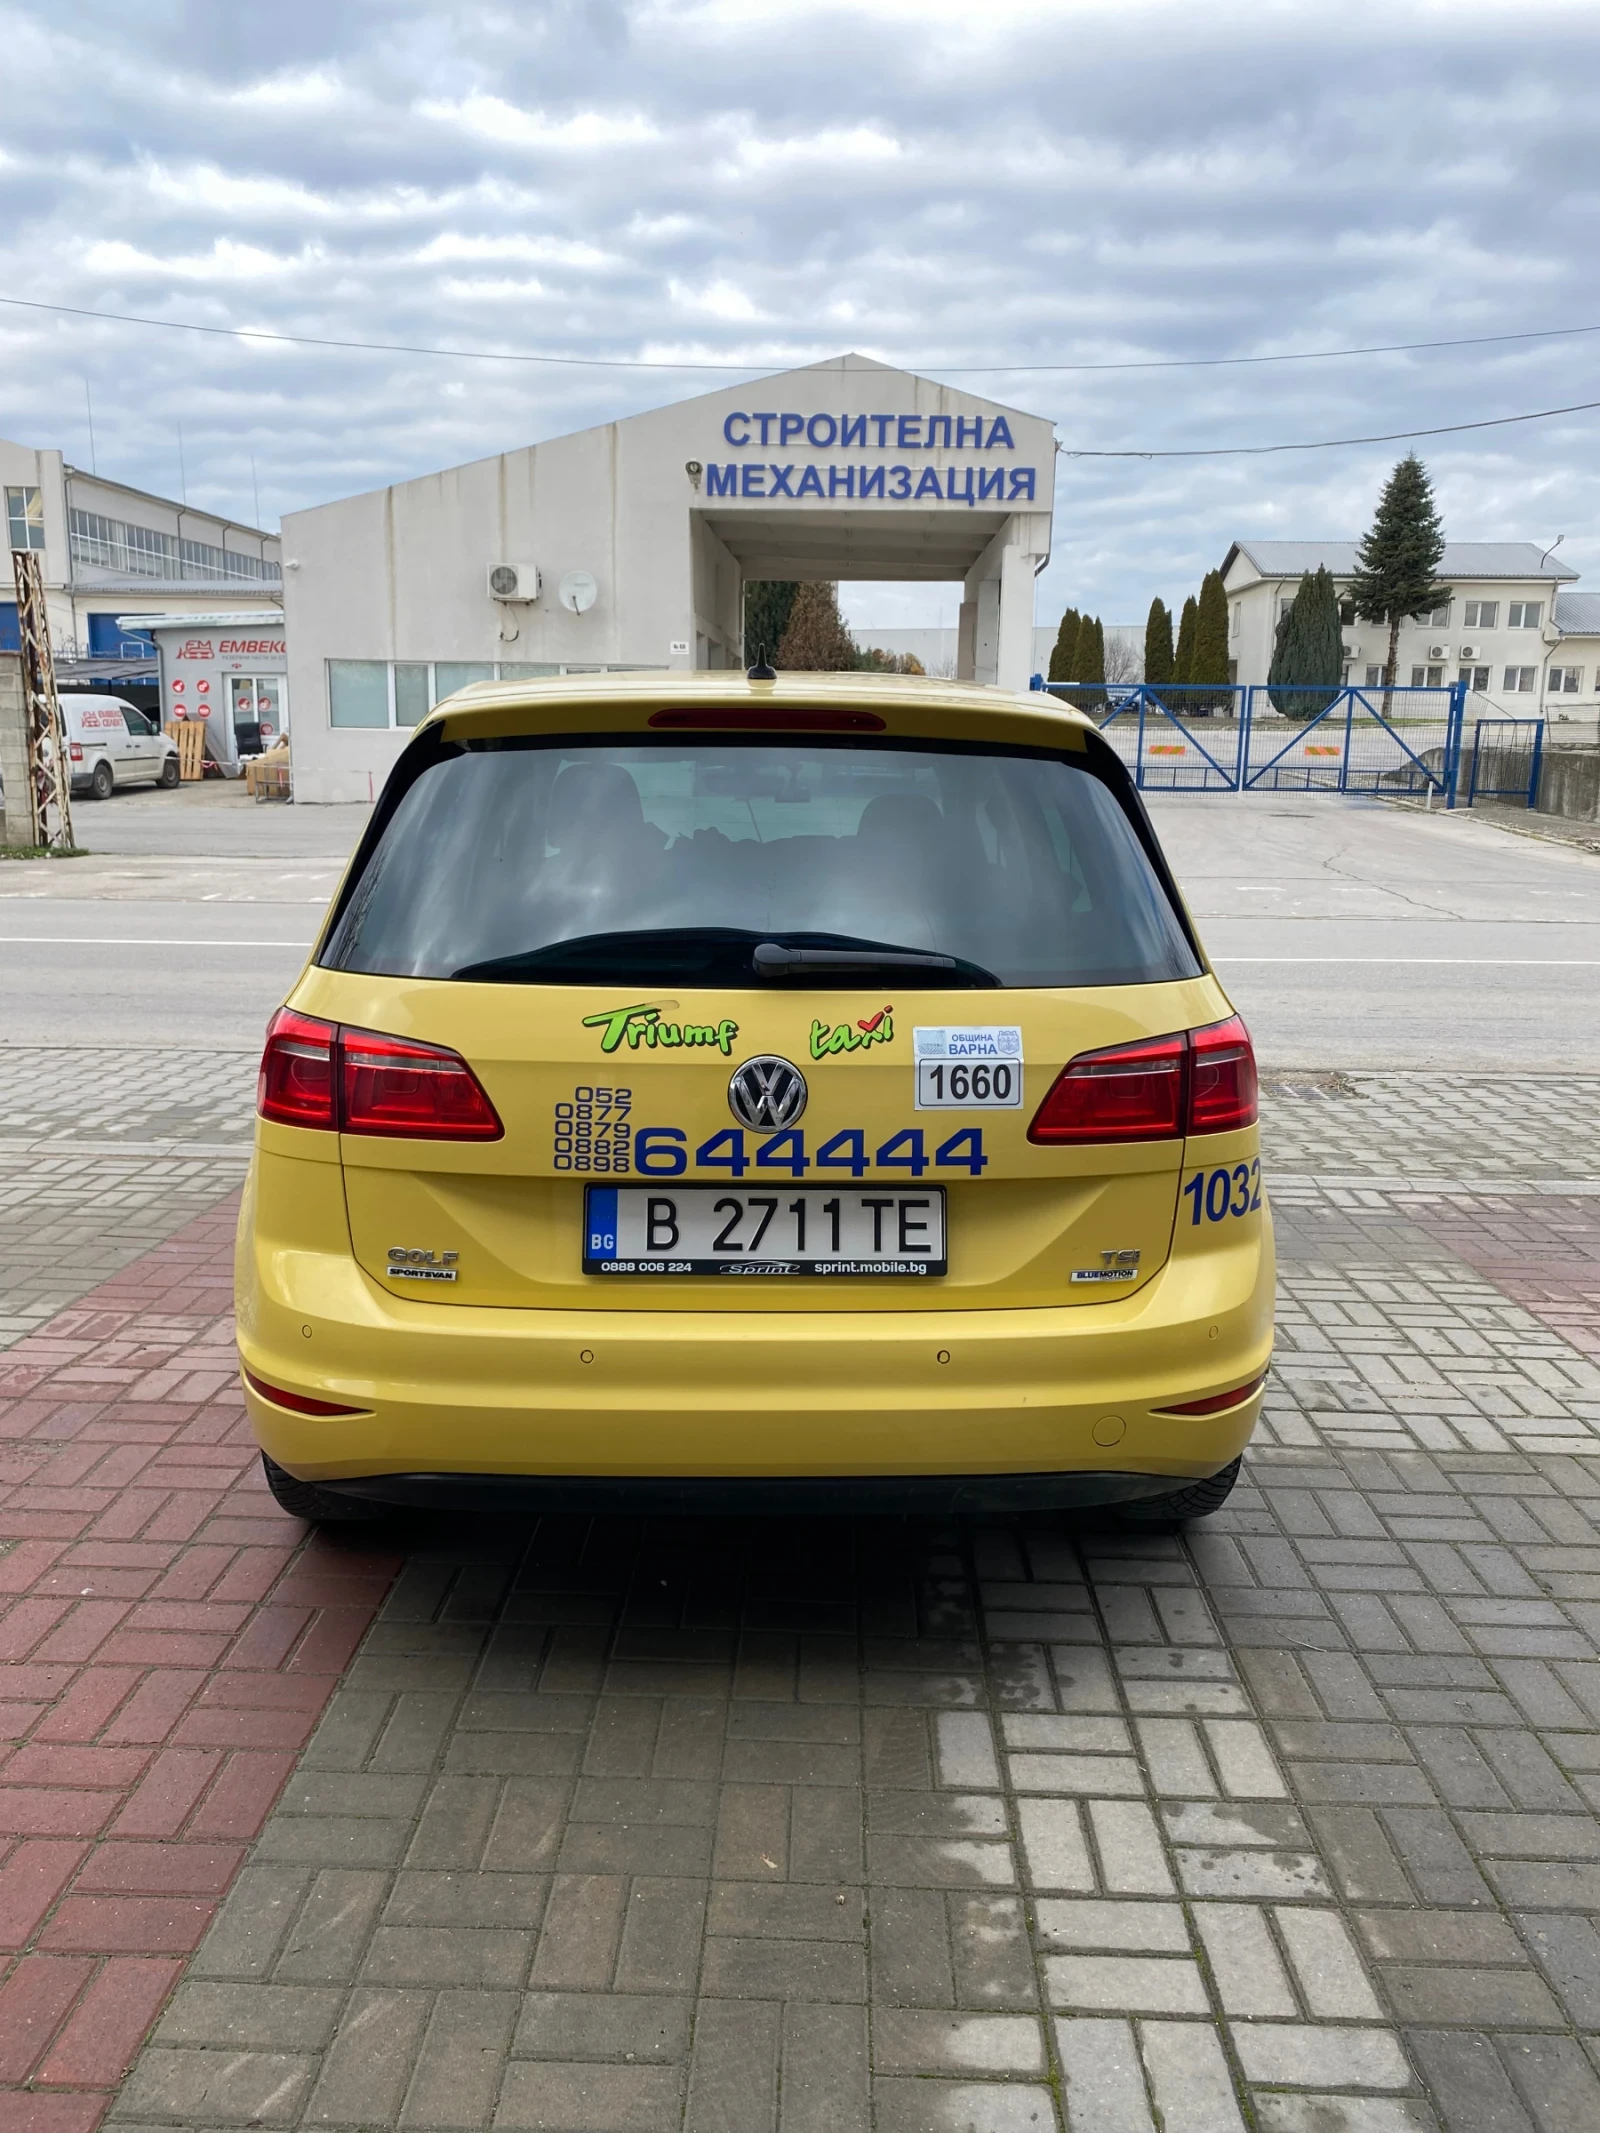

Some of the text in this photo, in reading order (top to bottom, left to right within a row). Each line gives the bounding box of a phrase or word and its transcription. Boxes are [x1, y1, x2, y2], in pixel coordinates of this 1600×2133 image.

[723, 412, 1015, 449] СТРОИТЕЛНА
[706, 464, 1036, 507] МЕХАНИЗАЦИЯ
[582, 1001, 893, 1060] Triumf taxi
[951, 1034, 994, 1043] ОБЩИНА
[948, 1043, 998, 1055] ВАРНА
[930, 1064, 1012, 1100] 1660
[575, 1086, 632, 1105] 052
[555, 1103, 632, 1121] 0877
[554, 1120, 631, 1139] 0879
[554, 1137, 630, 1156] 0882
[634, 1127, 989, 1177] 644444
[553, 1154, 630, 1173] 0898
[1184, 1157, 1262, 1226] 1032
[646, 1198, 932, 1252] B 2711 TE
[591, 1234, 614, 1250] BG
[387, 1246, 458, 1266] GOLF
[389, 1268, 453, 1279] SPORTSVAN
[601, 1262, 692, 1272] 0888 006 224
[814, 1261, 927, 1275] sprint.mobile.bg
[1076, 1269, 1134, 1279] BLUEMOTION
